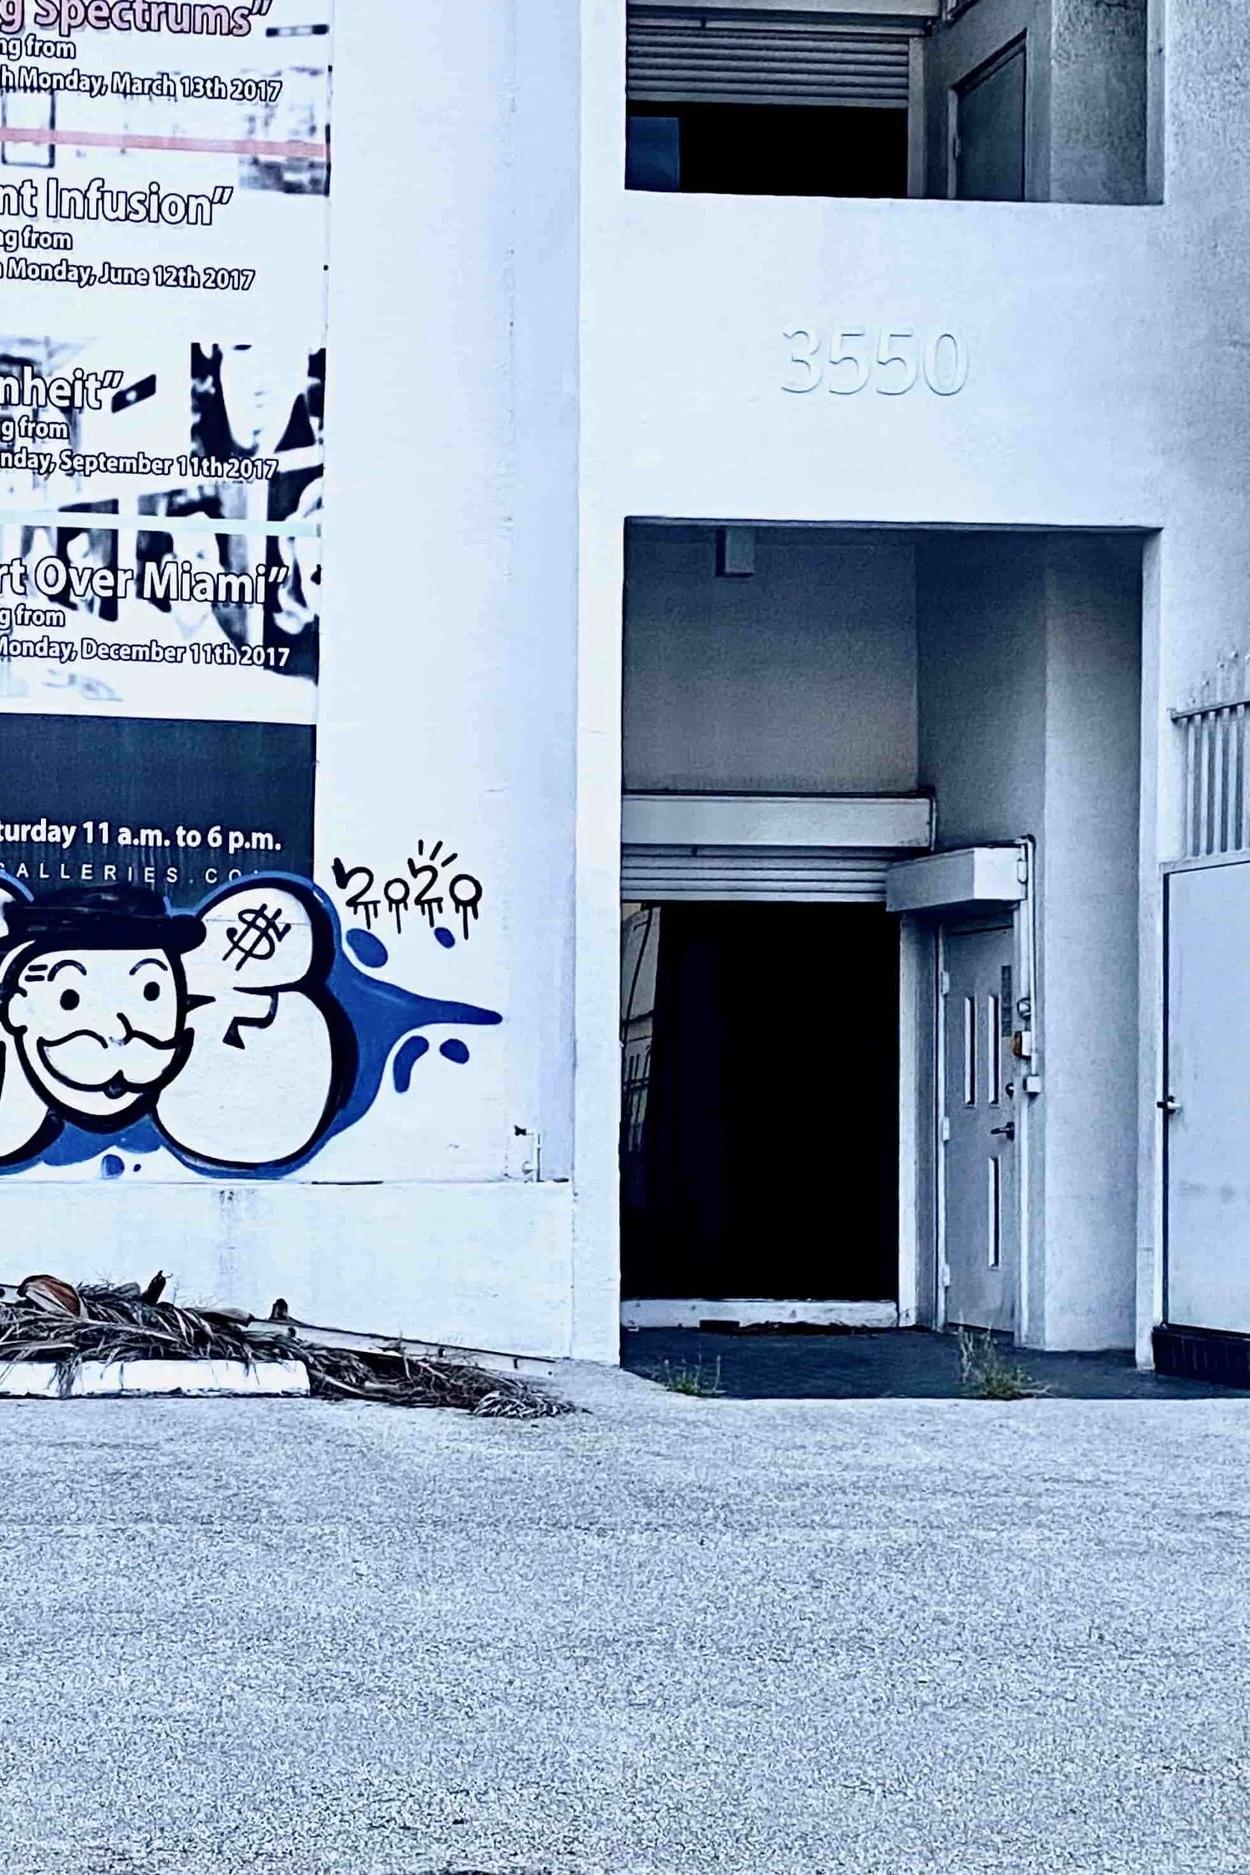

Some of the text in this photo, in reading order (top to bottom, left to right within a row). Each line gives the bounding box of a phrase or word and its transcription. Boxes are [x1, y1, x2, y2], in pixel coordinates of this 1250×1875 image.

[25, 33, 76, 59] from
[19, 66, 107, 97] Monday,
[111, 71, 176, 96] March
[181, 75, 227, 99] 13th
[230, 79, 282, 101] 2017
[47, 178, 234, 225] Infusion”
[21, 225, 72, 250] from
[6, 257, 97, 287] Monday,
[100, 262, 149, 285] June
[154, 265, 200, 287] 12th
[203, 268, 255, 290] 2017
[781, 324, 970, 397] 3550
[18, 416, 69, 439] from
[59, 451, 173, 476] September
[177, 455, 223, 478] 11th
[226, 457, 279, 480] 2017
[34, 555, 134, 598] Over
[142, 560, 289, 604] Miami”
[14, 603, 65, 627] from
[80, 638, 186, 663] December
[190, 643, 236, 665] 11th
[239, 645, 290, 667] 2017
[83, 821, 109, 843] 11
[118, 826, 170, 847] a.m.
[176, 826, 200, 848] to
[207, 825, 222, 848] 6
[228, 831, 281, 854] p.m.
[332, 857, 483, 932] 2020
